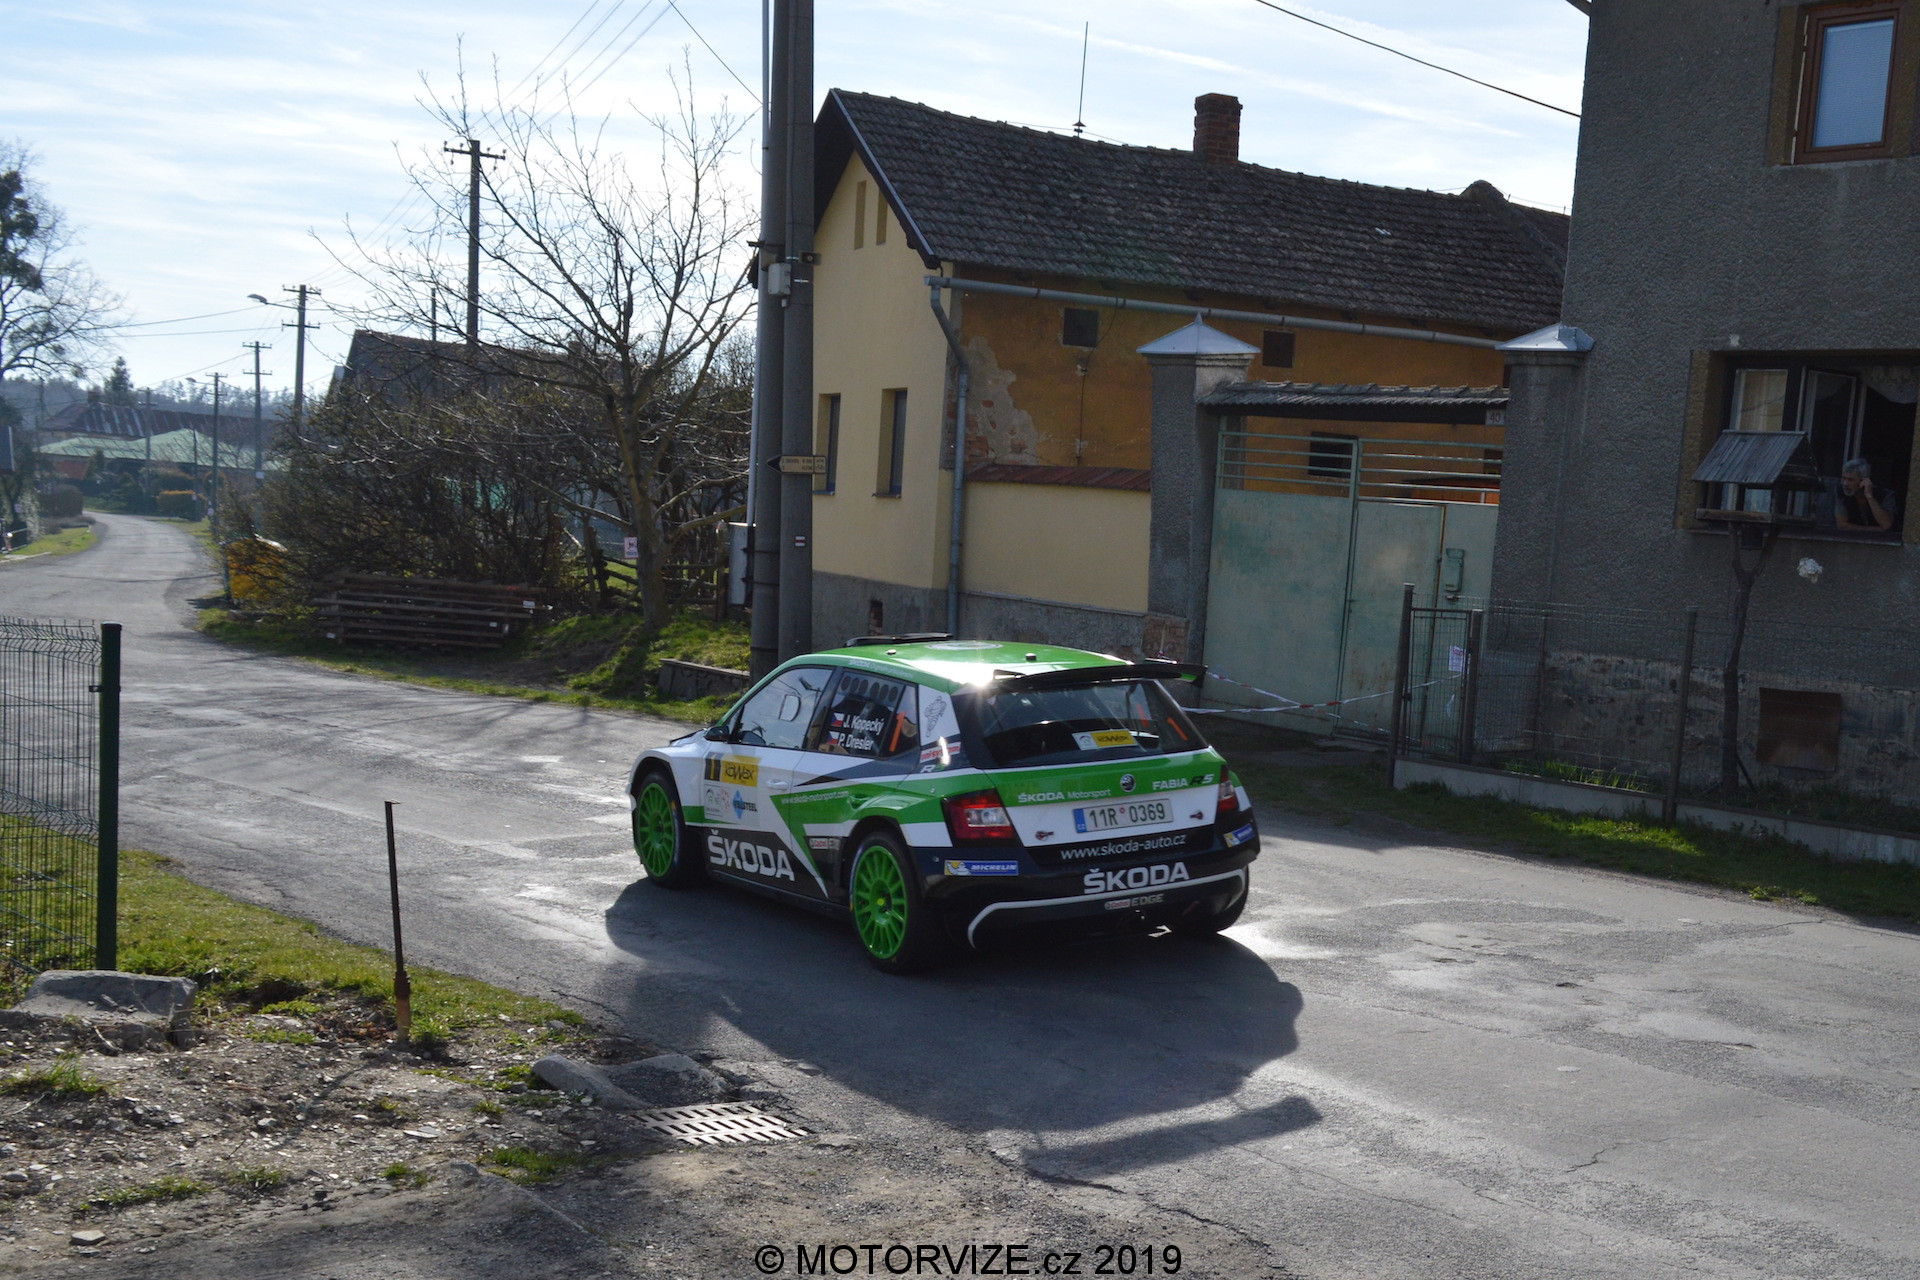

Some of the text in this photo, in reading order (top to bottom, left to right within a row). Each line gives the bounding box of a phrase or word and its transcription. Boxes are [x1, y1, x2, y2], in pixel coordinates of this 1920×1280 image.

[850, 715, 885, 736] Kopecký
[845, 733, 874, 751] Dresler
[1152, 778, 1188, 791] FABIA
[1018, 788, 1111, 803] ŠKODA Motorsport
[1089, 802, 1166, 828] 11R 0369
[707, 828, 796, 882] ŠKODA
[1060, 834, 1187, 860] www.skoda-auto.cz
[1083, 861, 1190, 895] ŠKODA
[1131, 893, 1164, 907] EDGE
